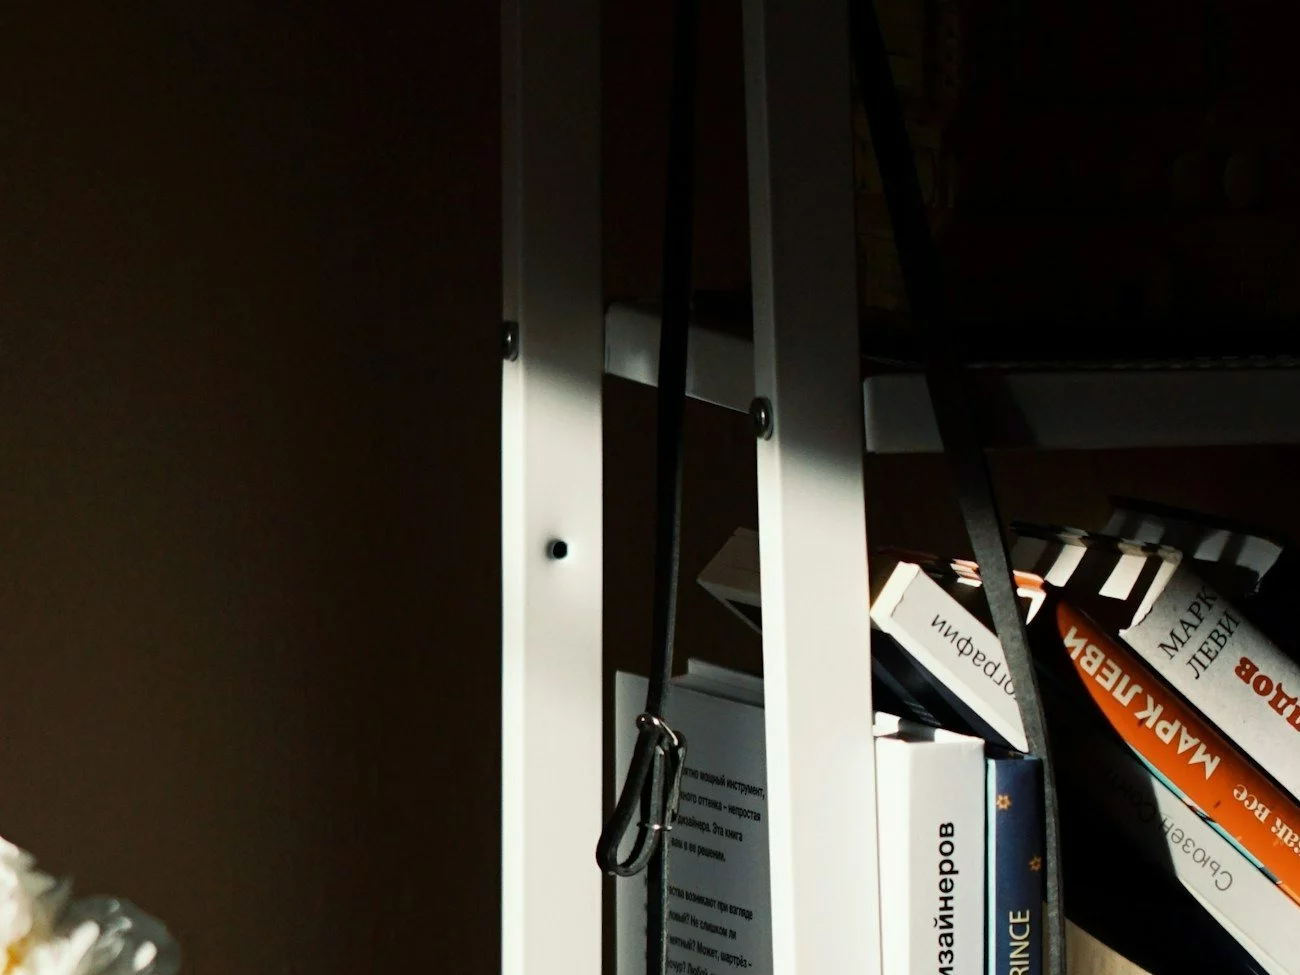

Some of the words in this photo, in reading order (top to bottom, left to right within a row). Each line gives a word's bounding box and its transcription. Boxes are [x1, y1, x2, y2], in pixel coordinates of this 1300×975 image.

[1157, 585, 1219, 661] МАРК
[1185, 608, 1241, 680] ЛЕВИ
[1063, 626, 1143, 708] ЛЕВИ
[1134, 693, 1220, 780] МАРК
[1232, 783, 1274, 823] все
